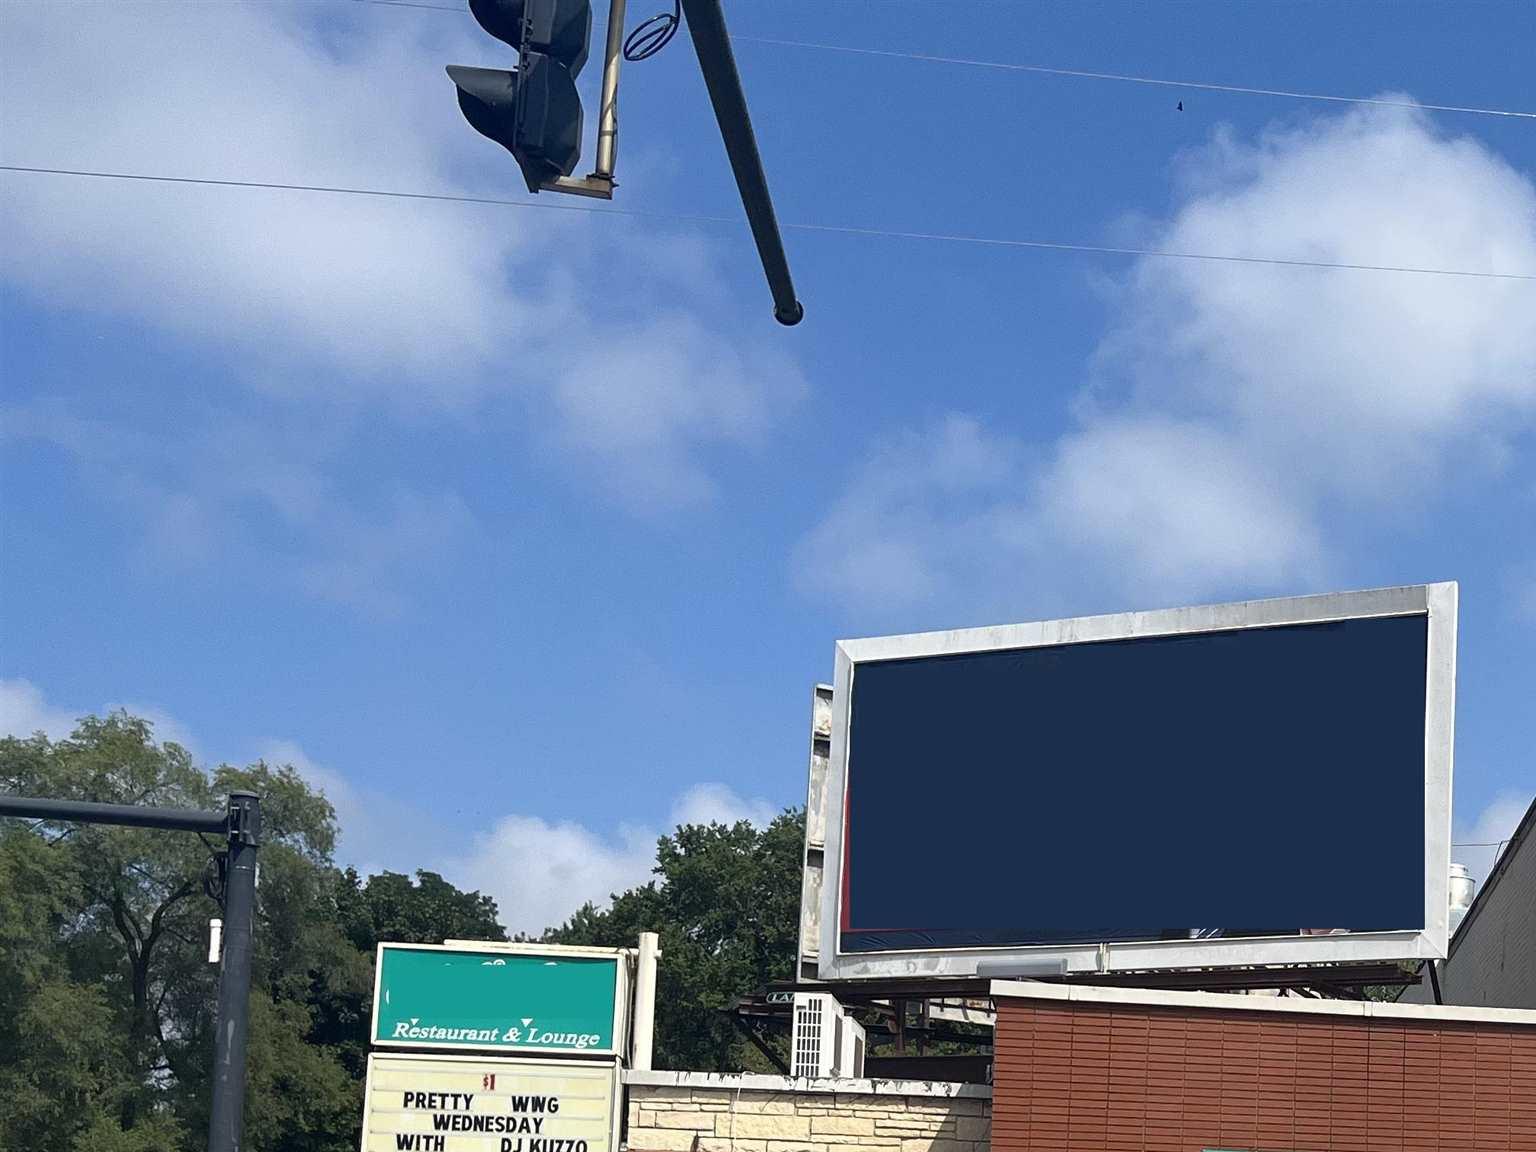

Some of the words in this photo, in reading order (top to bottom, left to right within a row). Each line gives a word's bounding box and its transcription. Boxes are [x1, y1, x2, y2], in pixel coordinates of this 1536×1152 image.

[392, 1021, 499, 1042] Restaurant
[502, 1026, 522, 1043] &
[528, 1028, 600, 1049] Lounge
[403, 1091, 474, 1111] PRETTY
[433, 1114, 544, 1134] WEDNESDAY
[396, 1134, 445, 1152] WITH
